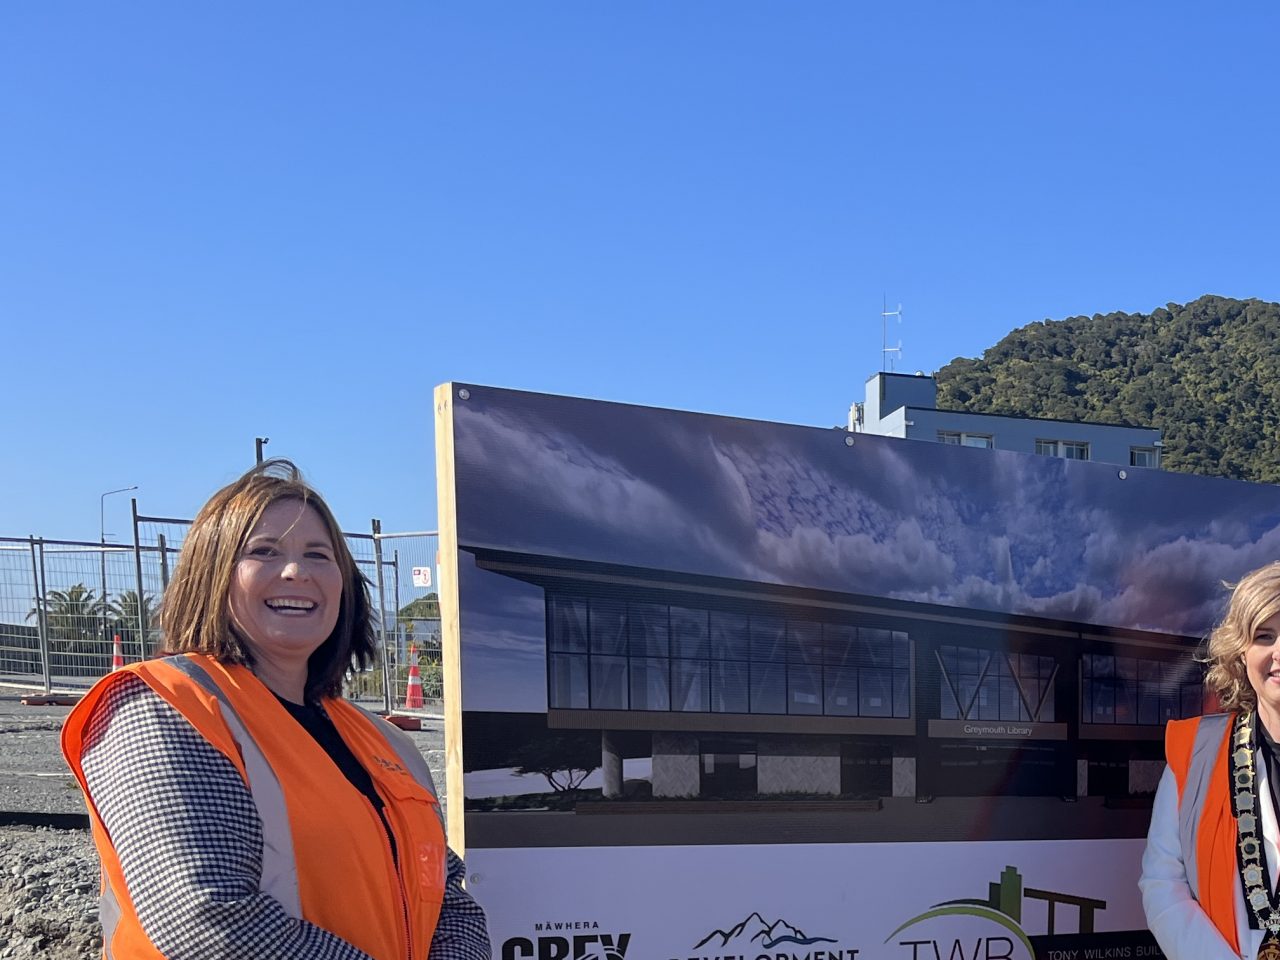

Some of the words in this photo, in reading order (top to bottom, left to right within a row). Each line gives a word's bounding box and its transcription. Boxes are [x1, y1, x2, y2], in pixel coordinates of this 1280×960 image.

[964, 724, 1006, 736] Greymouth
[1007, 726, 1033, 737] Library
[1084, 946, 1132, 960] WILKINS
[1136, 944, 1163, 957] BUIL
